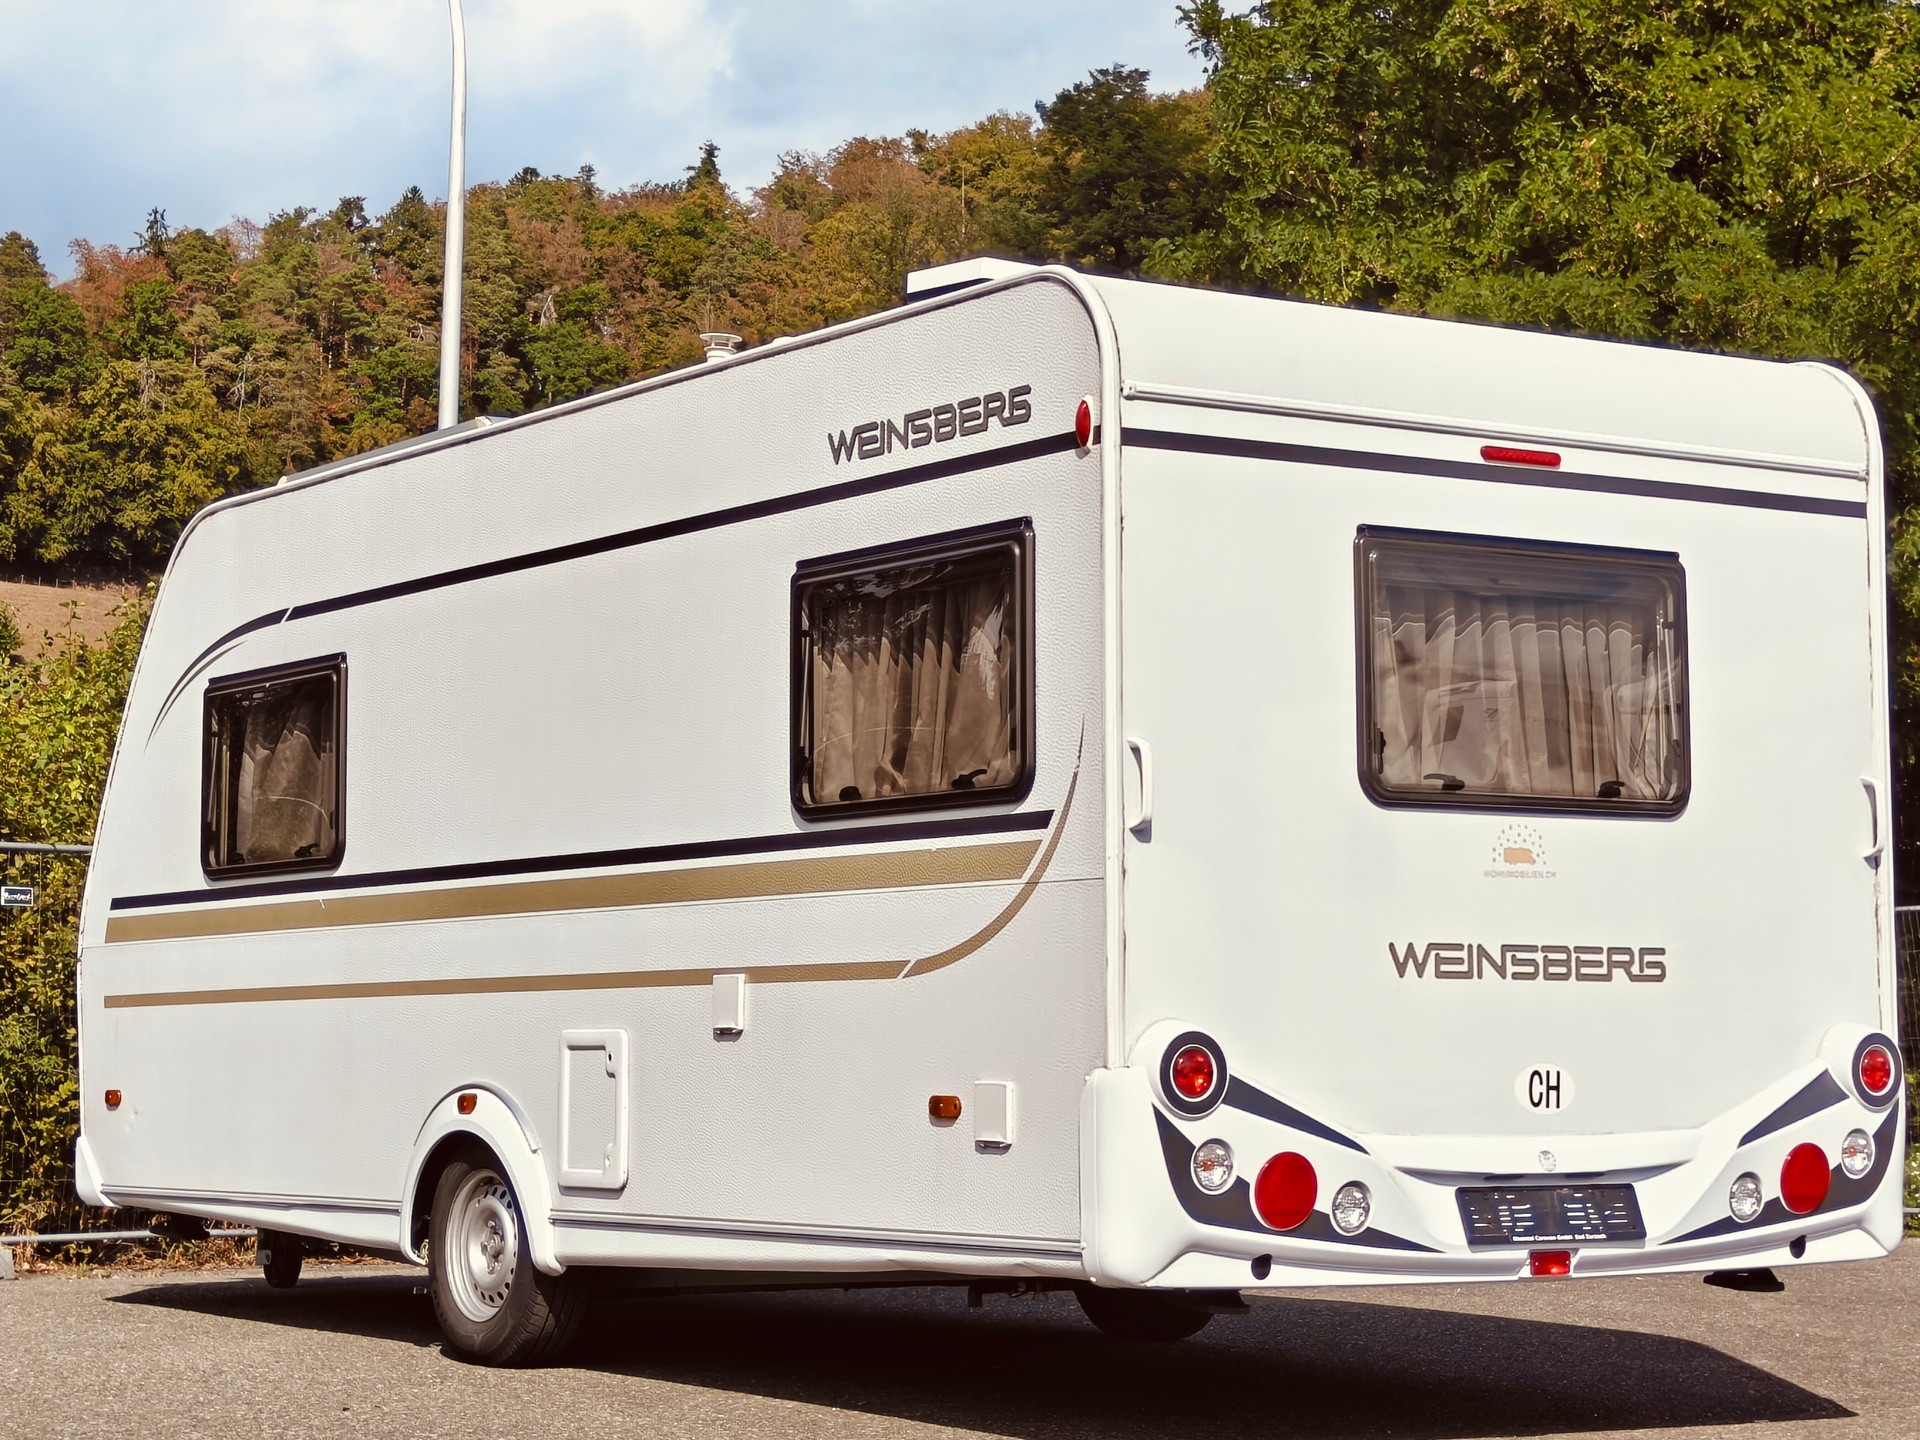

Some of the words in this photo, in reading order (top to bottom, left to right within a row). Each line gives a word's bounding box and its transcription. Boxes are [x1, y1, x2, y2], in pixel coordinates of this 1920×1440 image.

[828, 384, 1032, 466] WEINSBERG
[1388, 942, 1667, 983] WEINSBERG
[1528, 1069, 1561, 1109] CH
